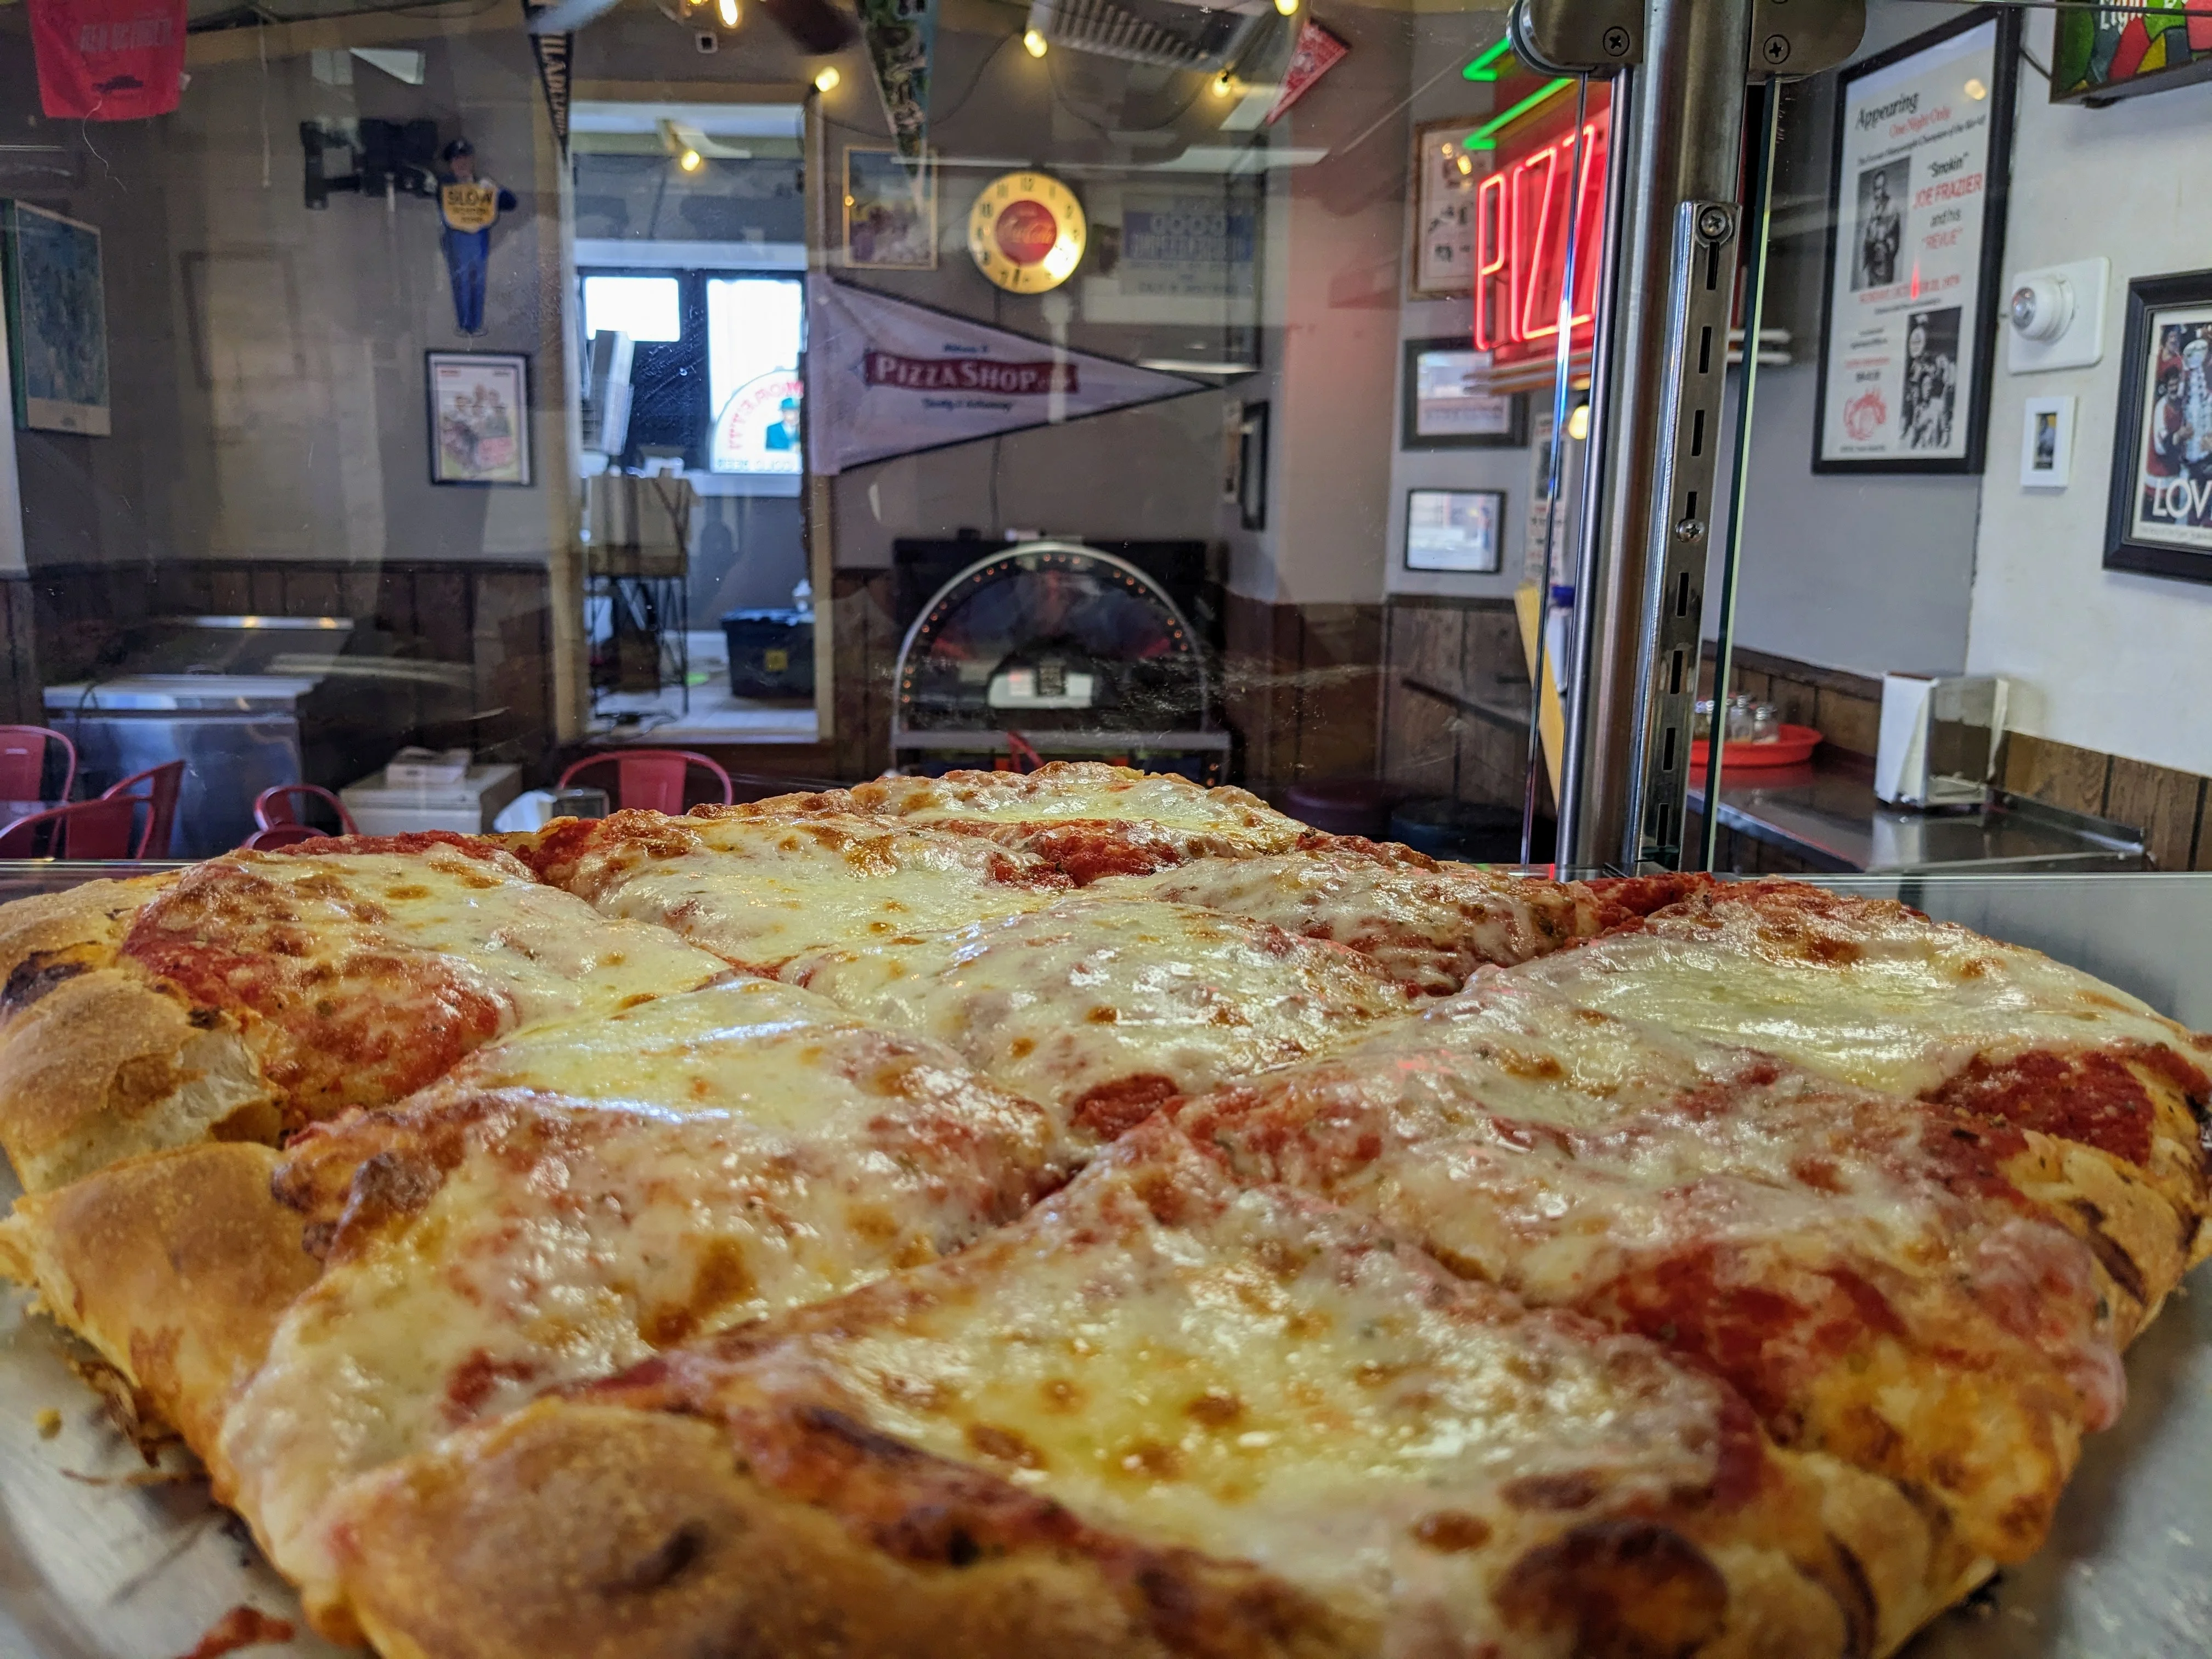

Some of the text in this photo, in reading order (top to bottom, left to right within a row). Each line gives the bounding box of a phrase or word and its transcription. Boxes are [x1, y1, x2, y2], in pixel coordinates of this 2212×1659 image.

[1855, 92, 1919, 131] Appearing
[1912, 172, 1983, 210] JOE FRAZIER
[1476, 123, 1599, 351] PIZZ
[2152, 477, 2212, 520] LOV
